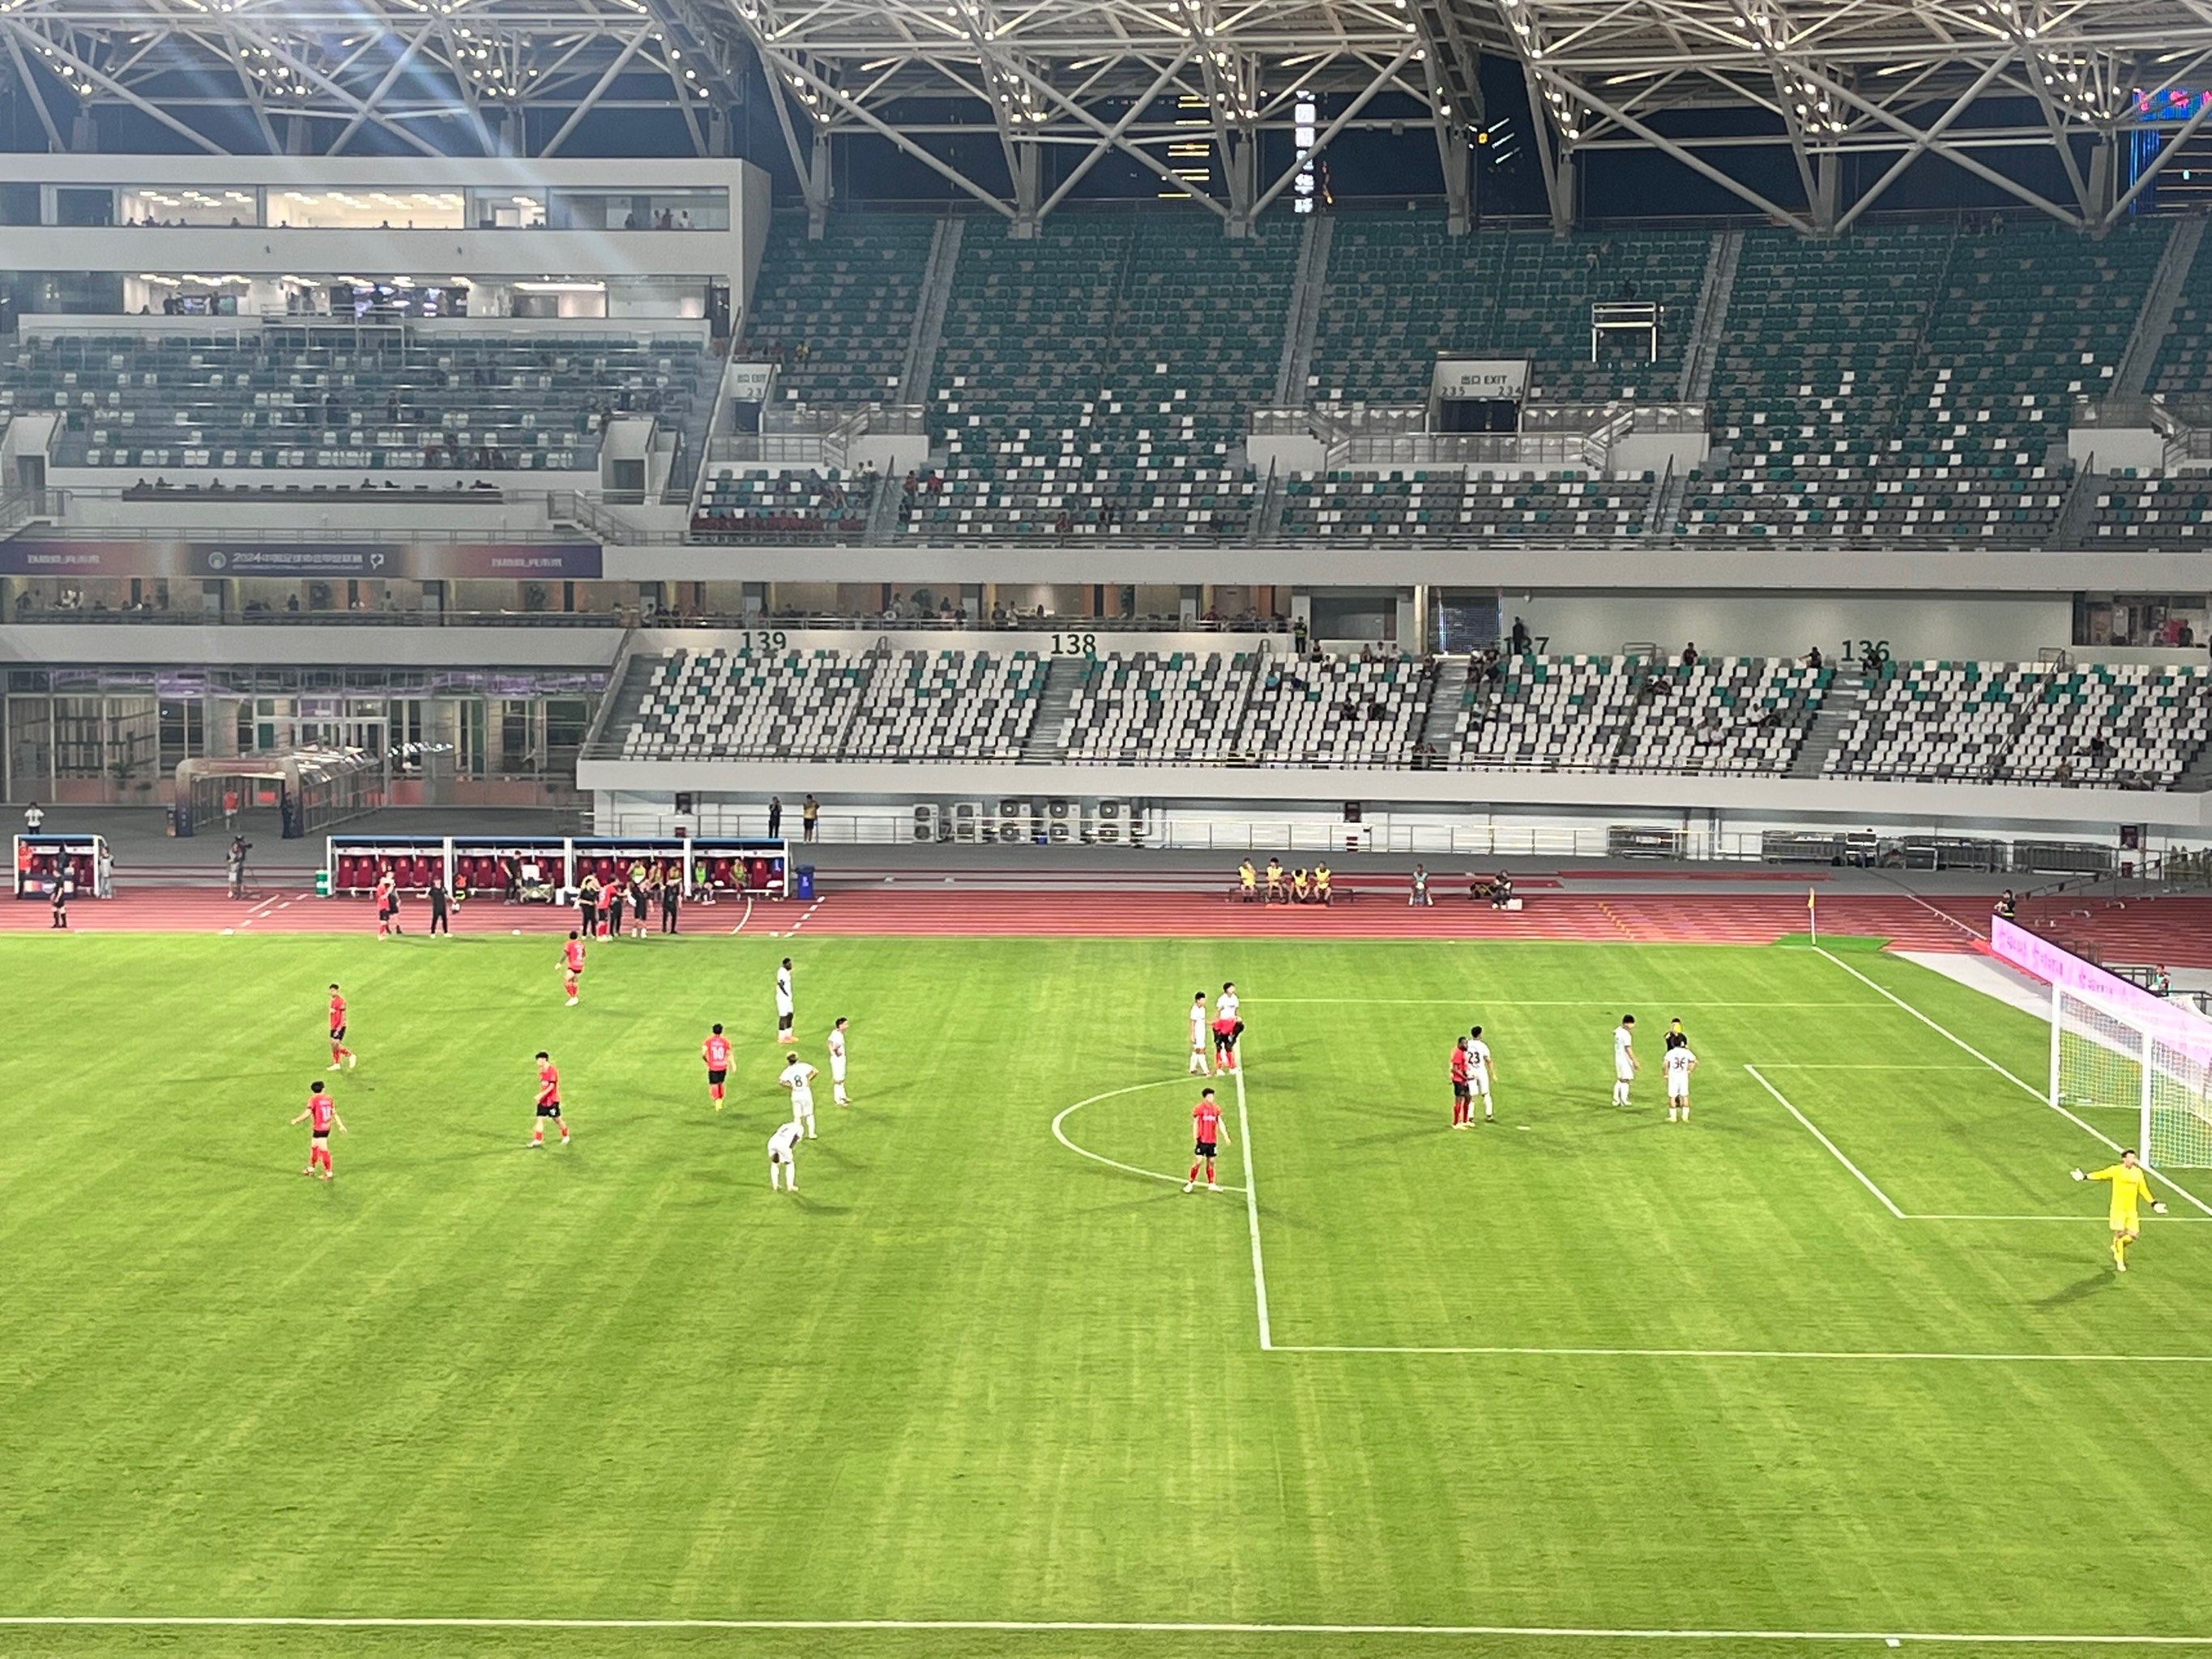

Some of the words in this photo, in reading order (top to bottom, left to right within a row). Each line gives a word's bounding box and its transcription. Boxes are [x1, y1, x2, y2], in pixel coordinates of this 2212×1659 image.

[1461, 375, 1481, 385] 出口
[1484, 375, 1508, 385] EXIT
[741, 631, 787, 651] 139
[1050, 633, 1096, 655] 138
[1840, 639, 1890, 662] 136
[1467, 1051, 1480, 1064] 23
[793, 1074, 803, 1087] 8
